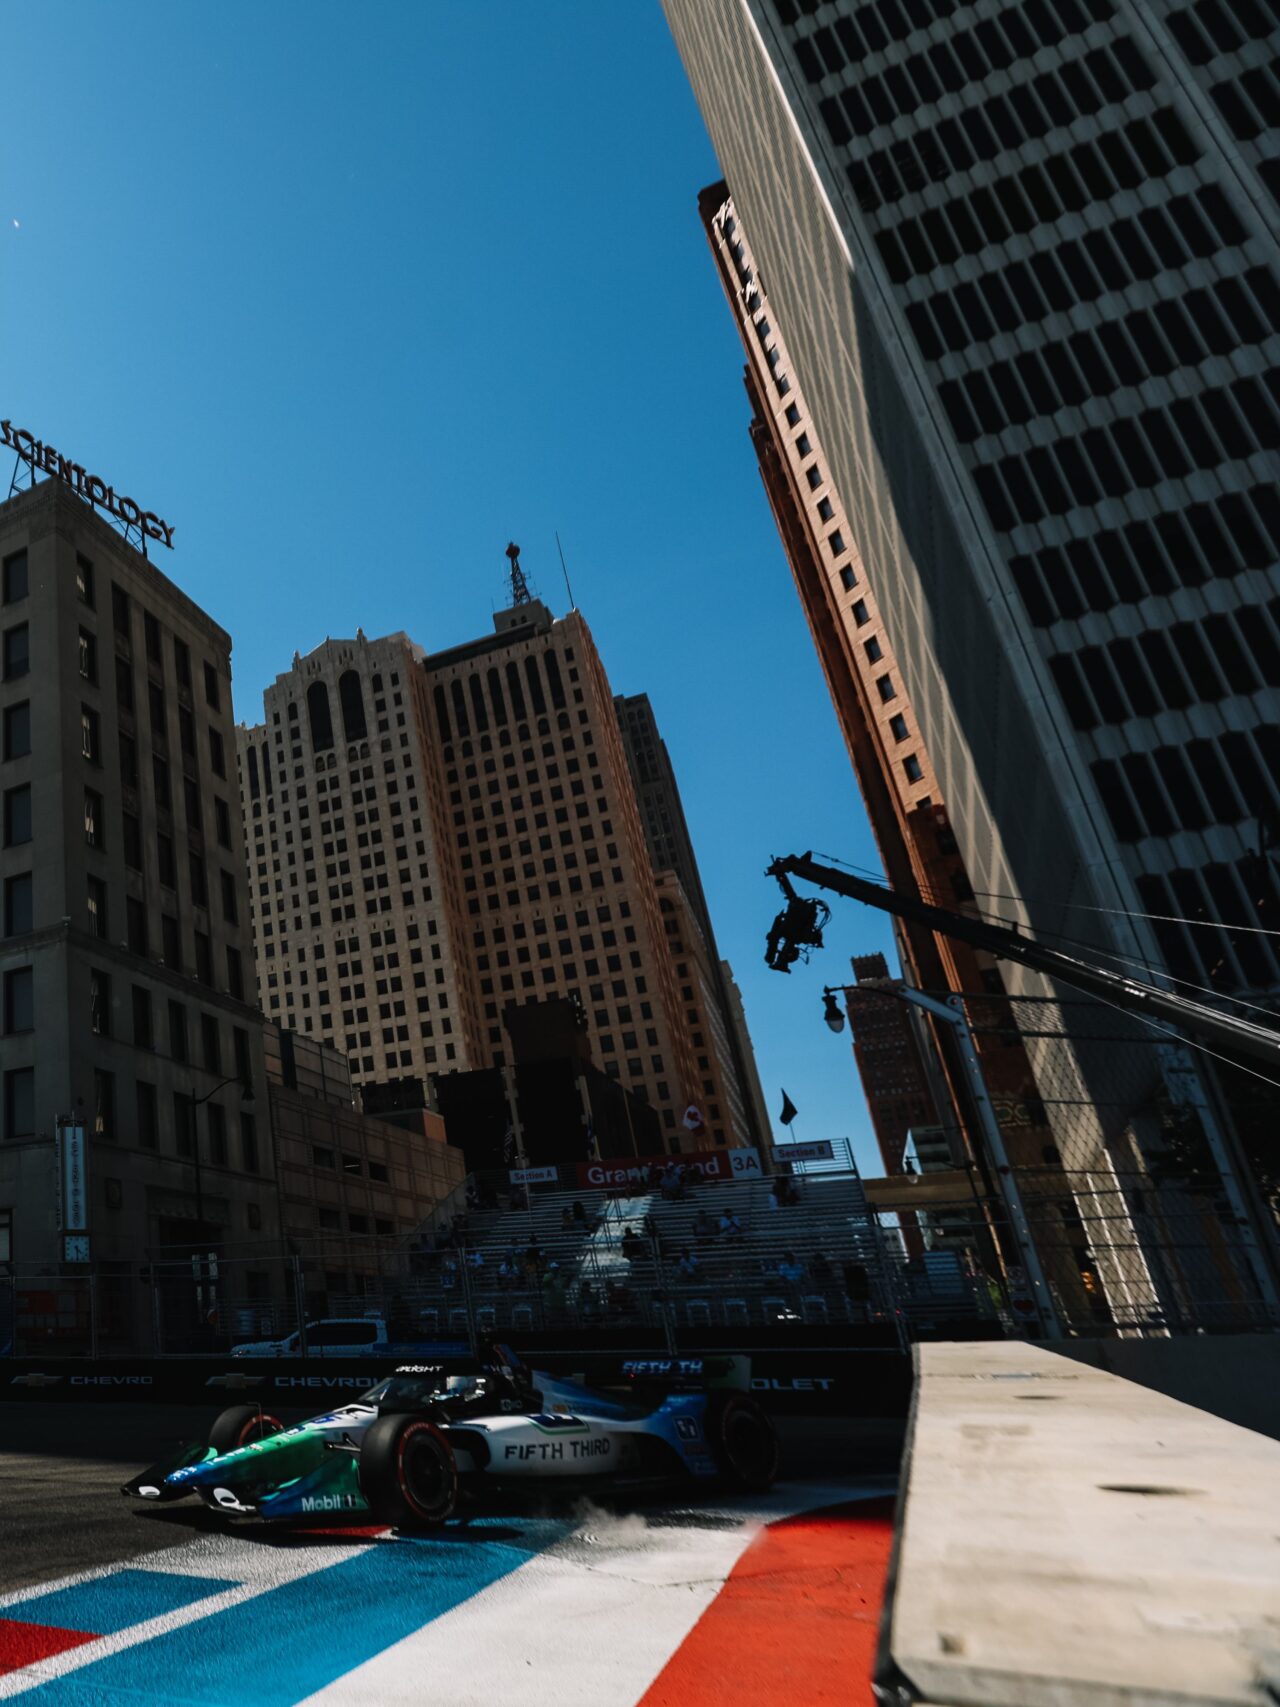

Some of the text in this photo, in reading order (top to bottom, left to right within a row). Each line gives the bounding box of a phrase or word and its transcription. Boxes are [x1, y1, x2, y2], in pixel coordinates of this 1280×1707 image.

[0, 419, 175, 549] SCIENTOLOGY
[546, 1168, 553, 1179] A
[586, 1151, 759, 1185] Grannd 3A
[623, 1360, 704, 1374] FIFTH TH
[751, 1377, 835, 1391] OLET
[504, 1437, 610, 1460] FIFTH THIRD
[301, 1493, 341, 1513] Mobil
